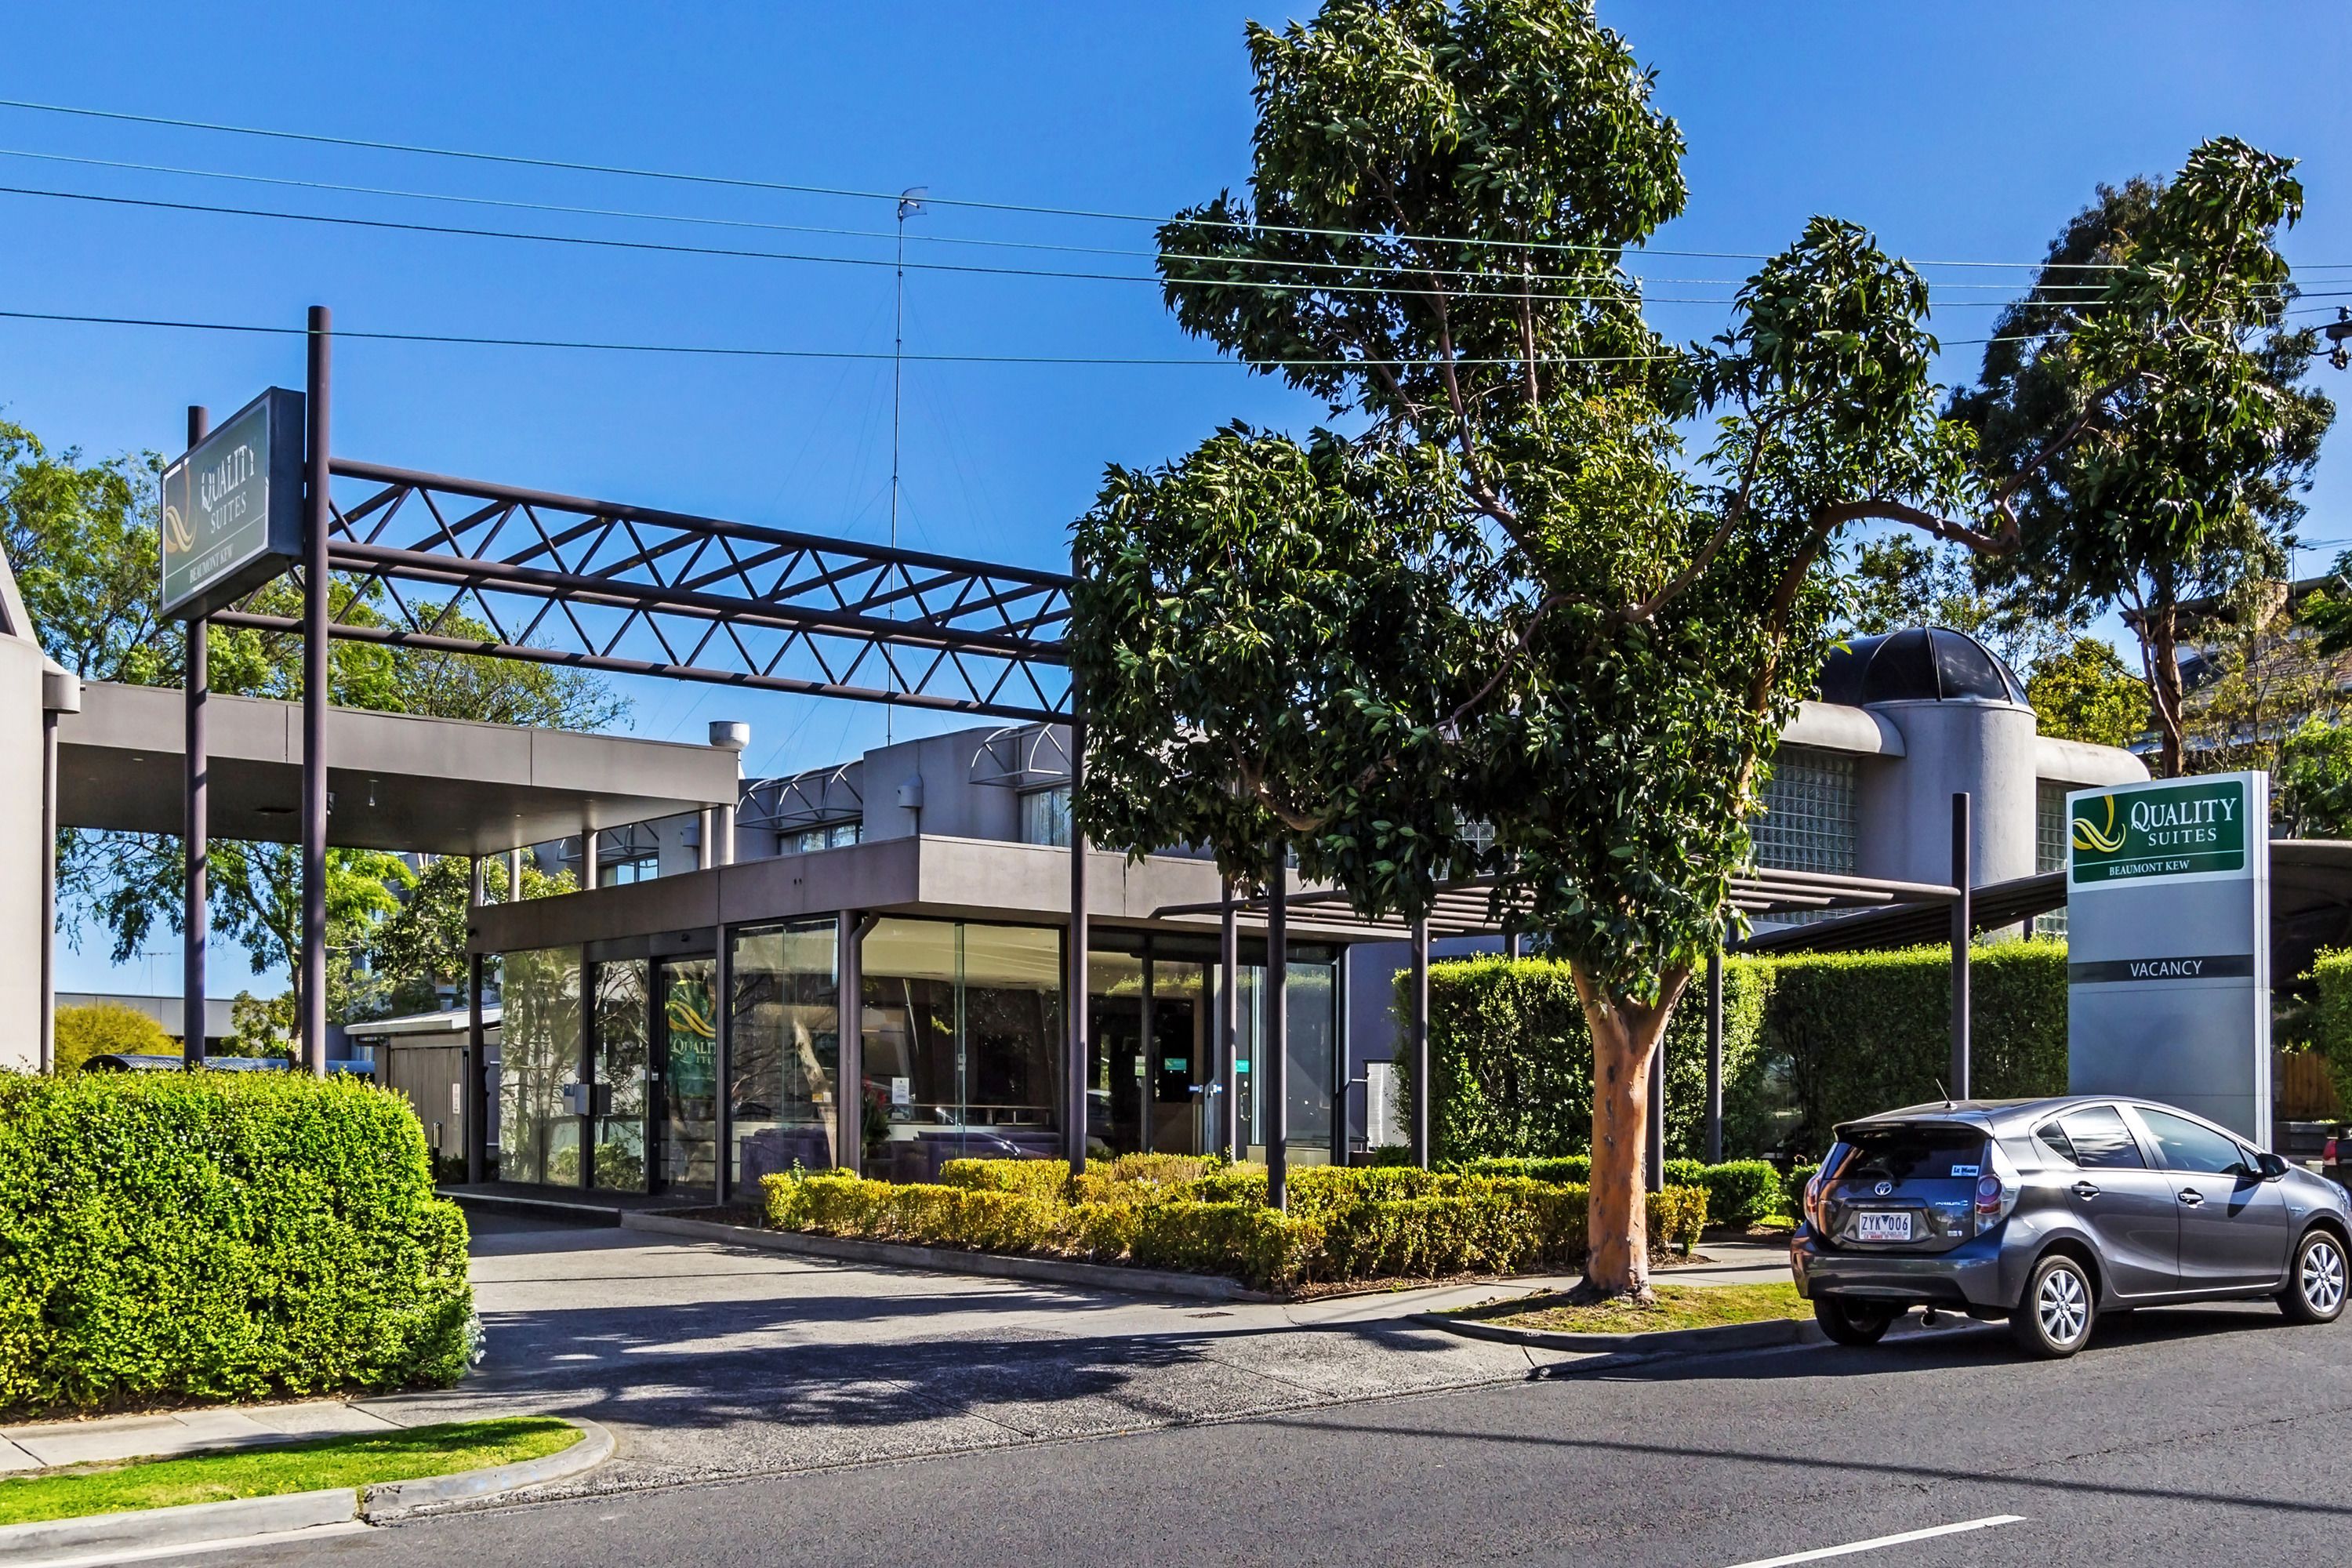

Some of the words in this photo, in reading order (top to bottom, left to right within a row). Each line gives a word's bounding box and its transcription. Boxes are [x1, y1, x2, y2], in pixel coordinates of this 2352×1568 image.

[201, 445, 255, 512] QUALITY
[211, 492, 247, 534] SUITES
[2131, 797, 2237, 832] QUALITY
[2148, 828, 2217, 847] SUITES
[2109, 862, 2164, 877] BEAUMONT
[2165, 859, 2190, 871] KEW
[2130, 960, 2202, 977] VACANCY
[671, 1038, 716, 1054] QUALIT
[1862, 1216, 1881, 1230] ZYK
[1889, 1216, 1908, 1231] 006
